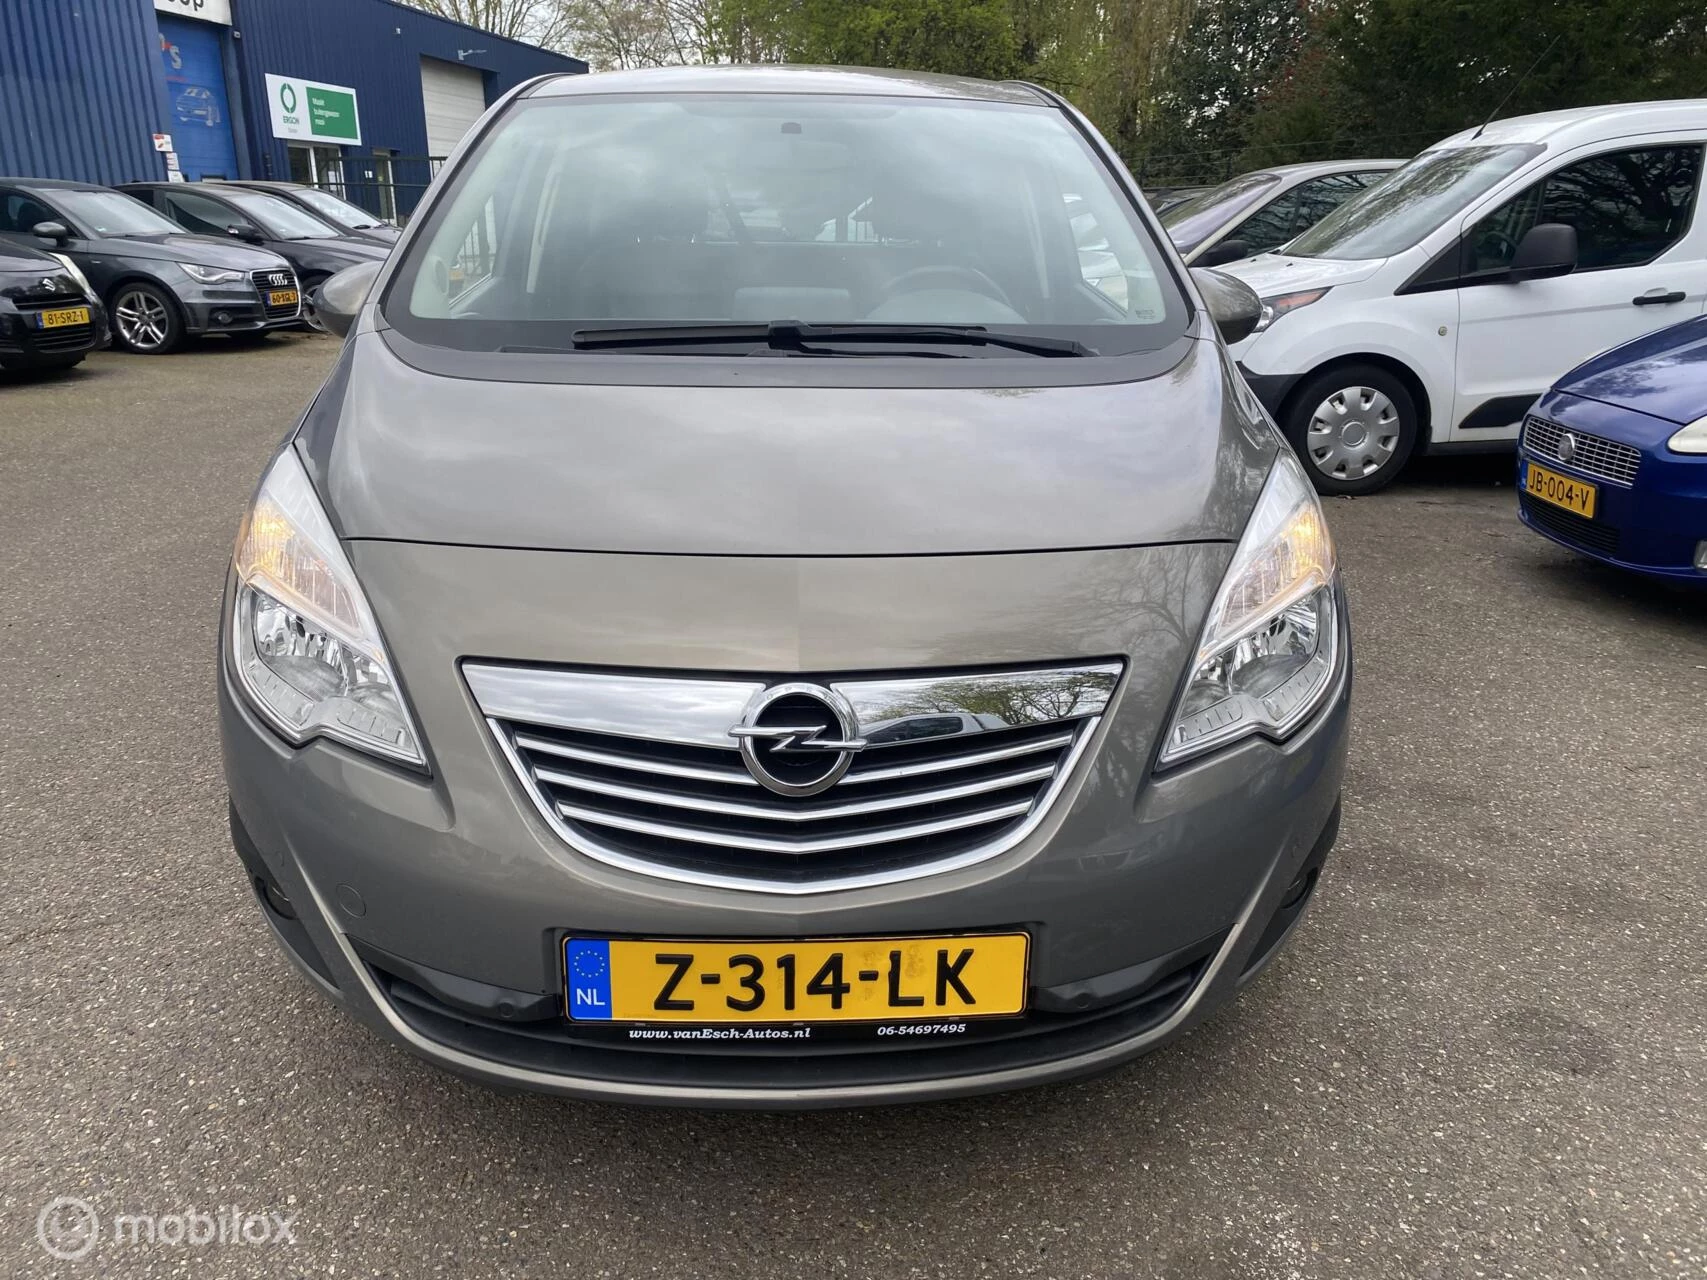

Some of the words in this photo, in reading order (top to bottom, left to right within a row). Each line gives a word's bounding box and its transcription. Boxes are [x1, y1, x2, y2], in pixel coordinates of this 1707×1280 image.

[48, 310, 84, 325] 81-SRZ-1
[1529, 469, 1590, 511] JB-004-V
[653, 948, 976, 1011] Z-314-LK
[576, 988, 606, 1006] NL
[628, 1027, 811, 1039] www.vanEsch-Autos.nl
[877, 1023, 966, 1036] 06-54697495
